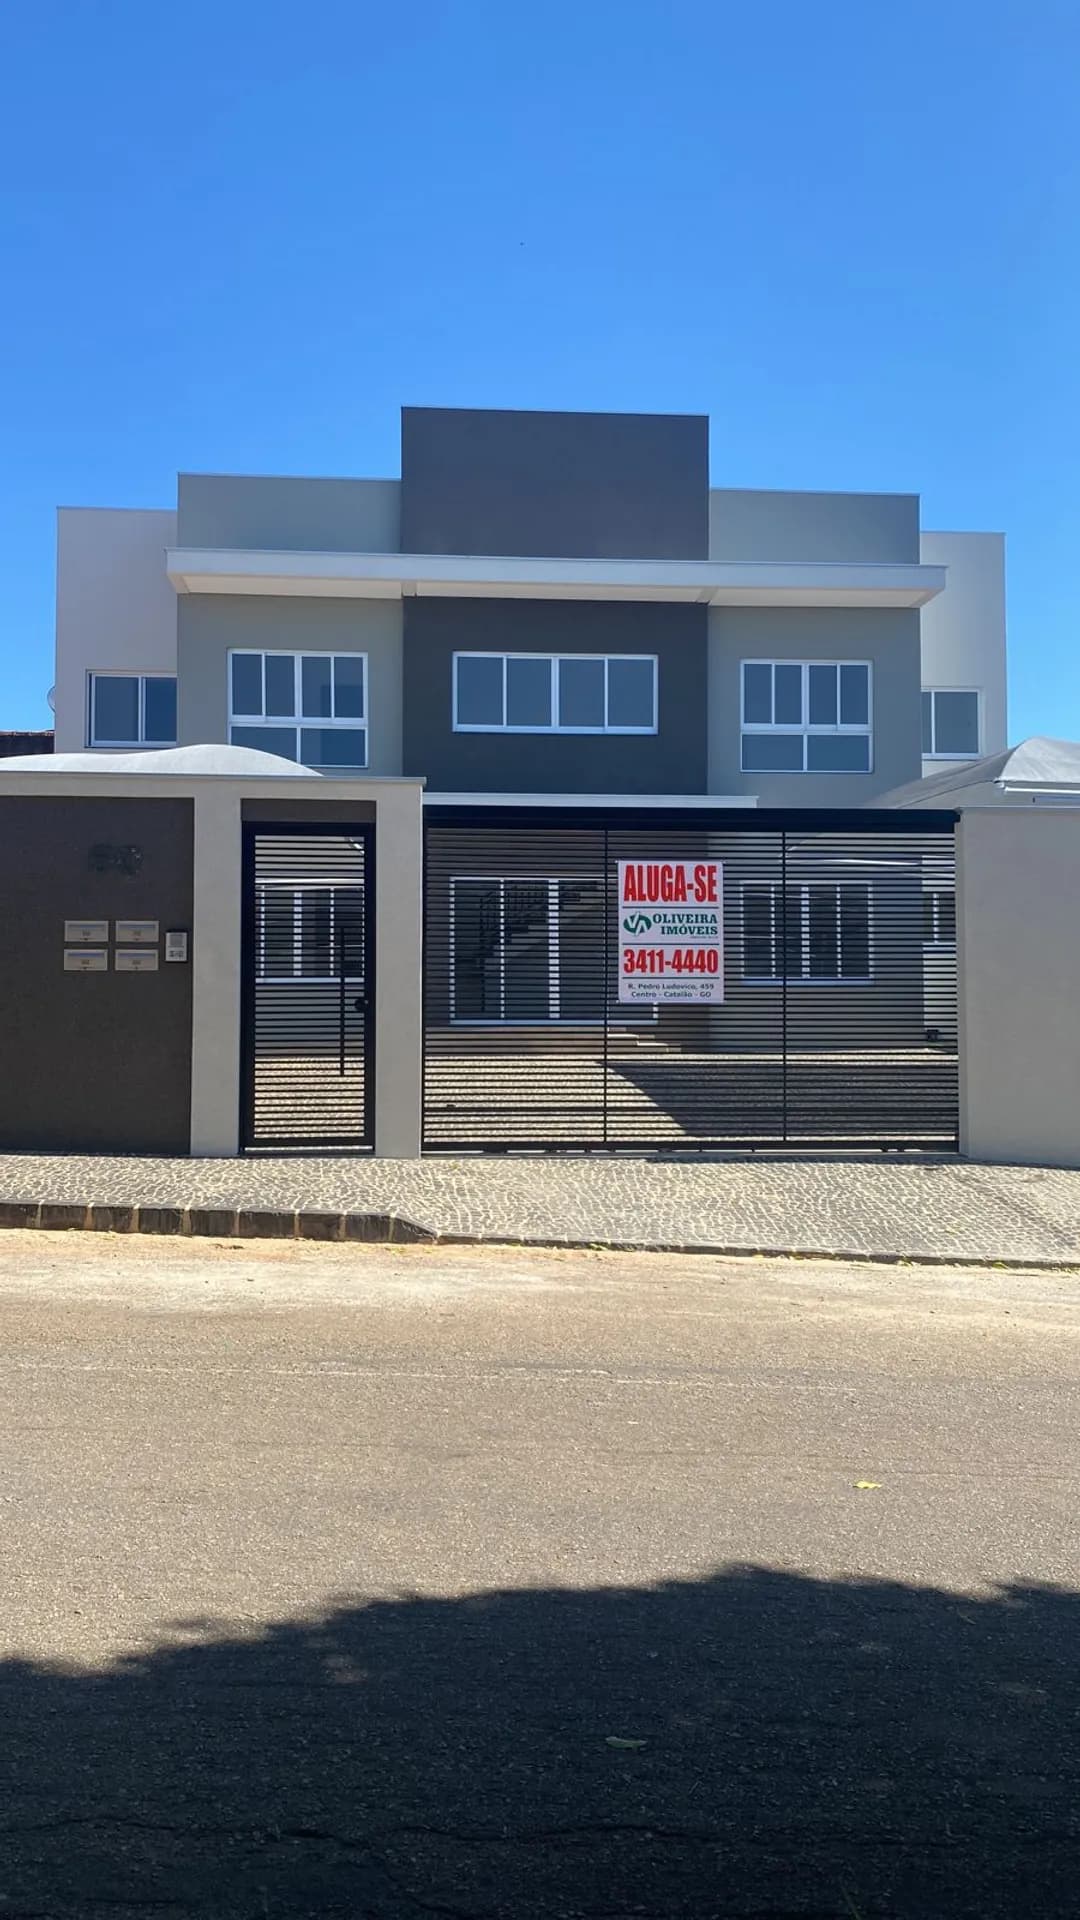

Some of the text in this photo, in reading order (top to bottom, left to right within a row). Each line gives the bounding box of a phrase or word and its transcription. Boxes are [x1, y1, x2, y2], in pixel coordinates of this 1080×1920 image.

[624, 865, 717, 902] ALUGA-SE
[653, 914, 718, 924] OLIVEIRA
[661, 924, 718, 935] IMÓVEIS
[624, 949, 718, 974] 3411-4440
